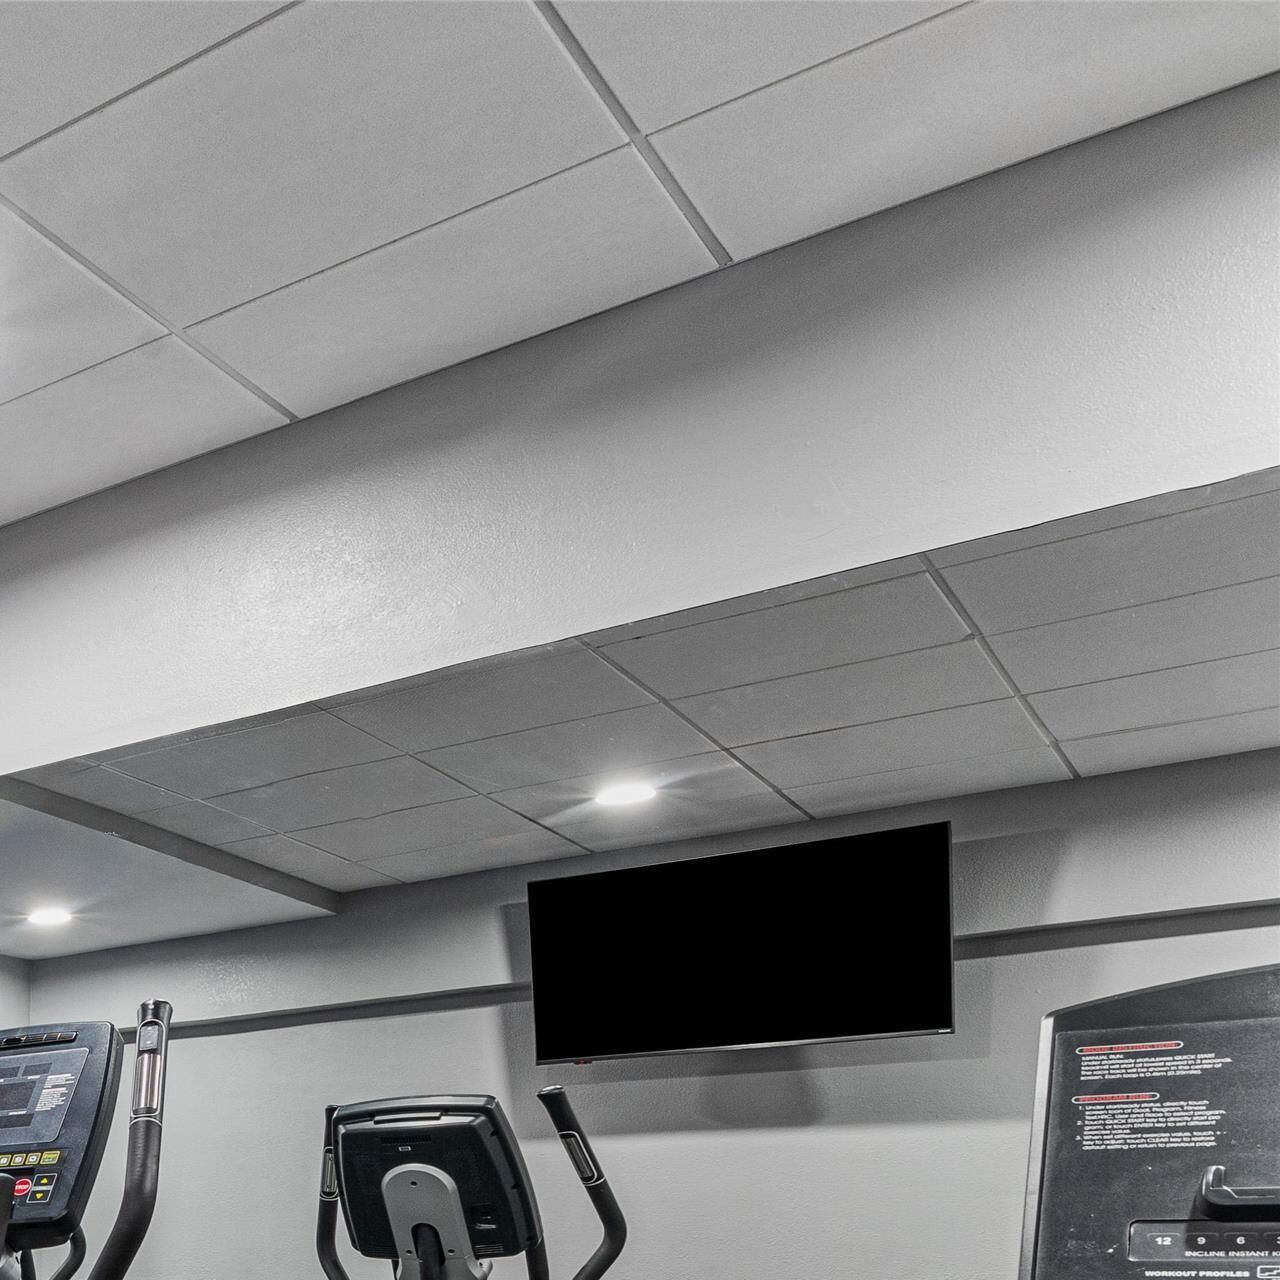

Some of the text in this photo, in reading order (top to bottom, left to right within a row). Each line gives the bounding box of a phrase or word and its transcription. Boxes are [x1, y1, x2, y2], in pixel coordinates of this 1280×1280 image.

[1155, 1237, 1245, 1245] 12 9 6
